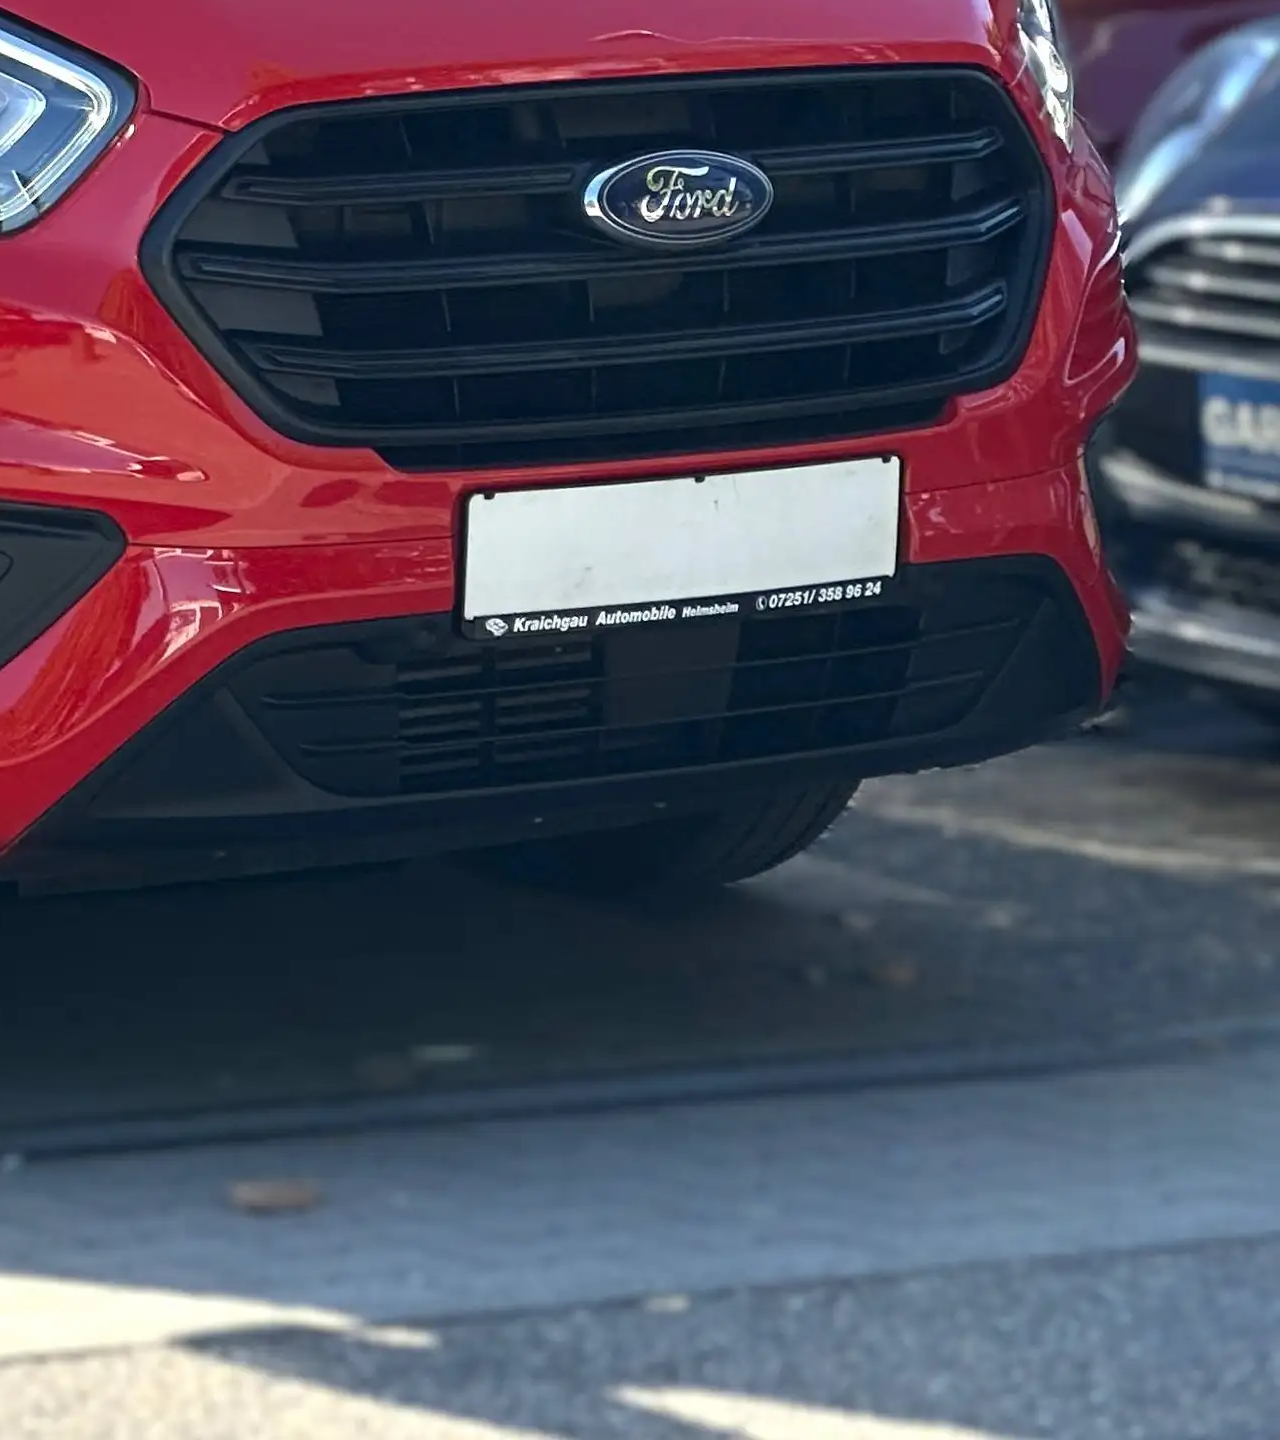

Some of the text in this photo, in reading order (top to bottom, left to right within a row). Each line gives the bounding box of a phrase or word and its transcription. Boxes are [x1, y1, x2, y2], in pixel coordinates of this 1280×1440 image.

[641, 165, 739, 223] Ford
[768, 580, 881, 609] 07251/ 358 96 24
[513, 602, 739, 632] Kraichgau Automobile Helmsheim
